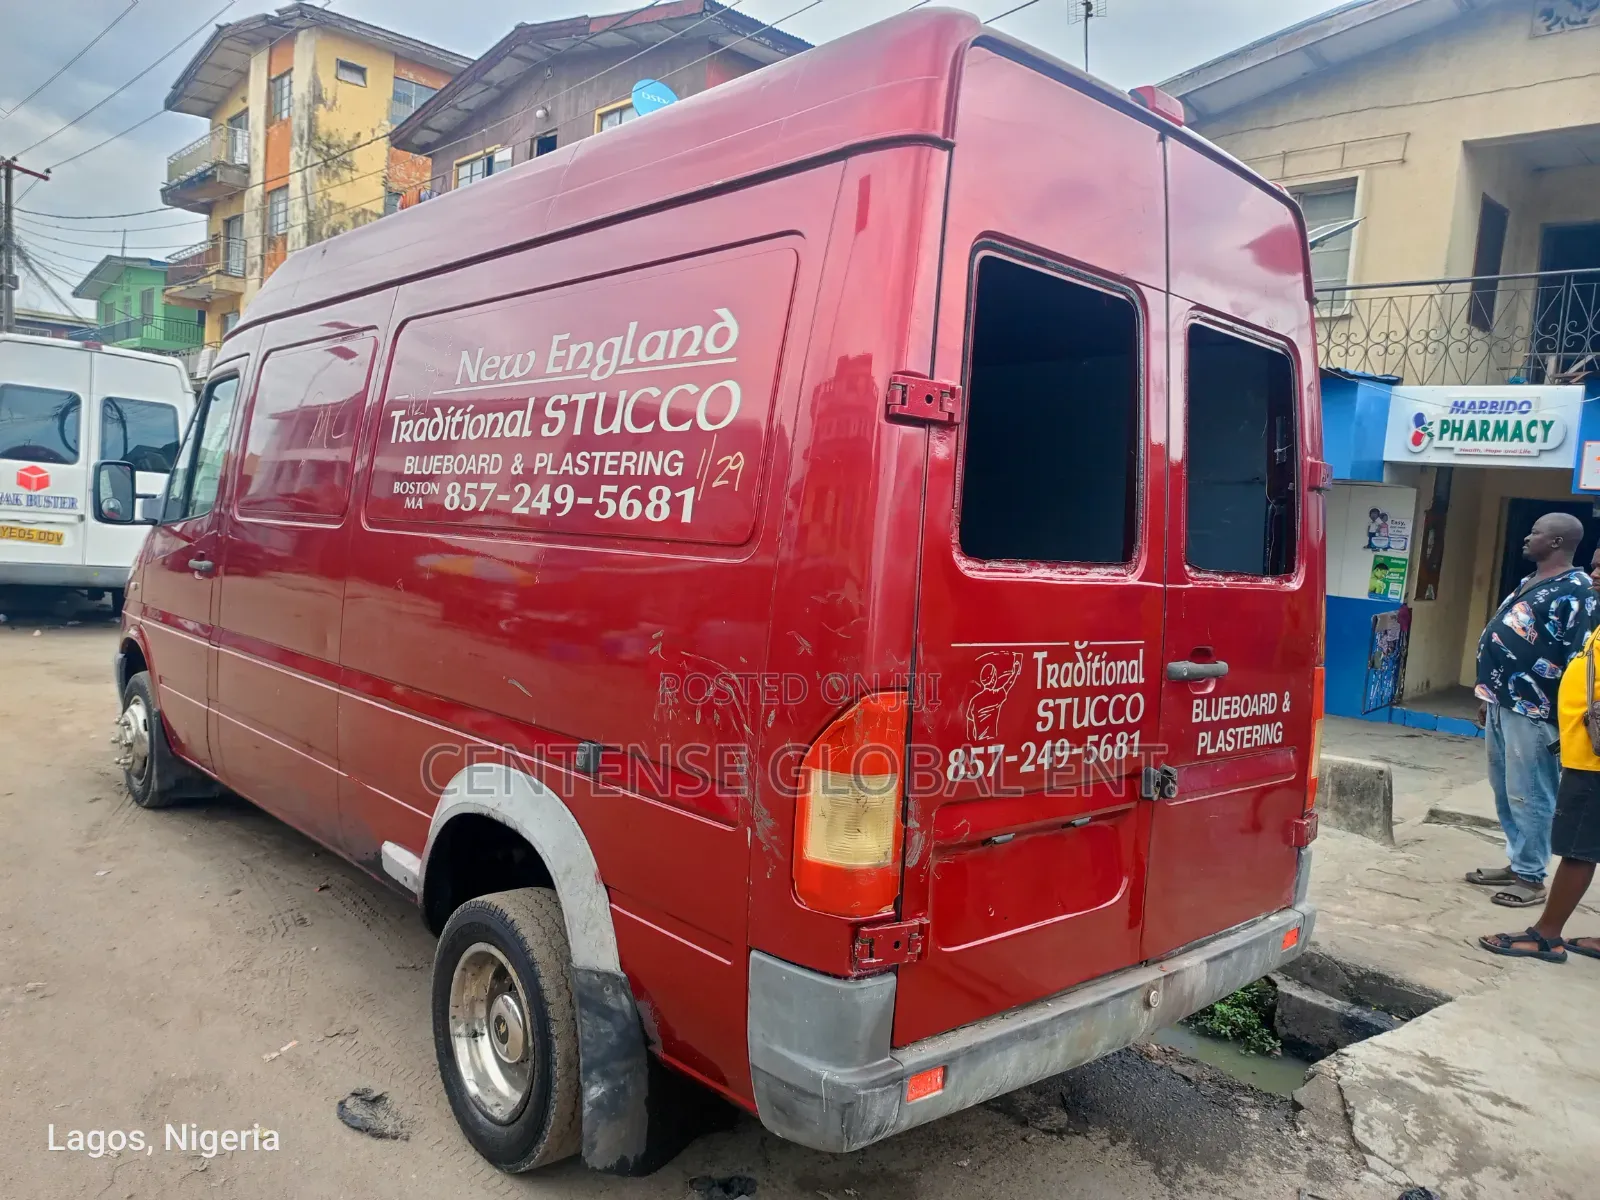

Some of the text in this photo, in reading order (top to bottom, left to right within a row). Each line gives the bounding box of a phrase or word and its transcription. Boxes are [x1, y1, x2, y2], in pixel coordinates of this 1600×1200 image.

[455, 308, 740, 385] New England
[390, 379, 742, 443] Traditional STUCCO
[1438, 419, 1556, 444] PHARMACY
[403, 450, 684, 476] BLUEBOARD & PLASTERING
[26, 494, 79, 510] BUSTER
[393, 481, 440, 495] BOSTON
[404, 496, 423, 510] MA
[443, 482, 696, 523] 857-249-5681
[1033, 648, 1145, 690] Traditional
[1036, 692, 1145, 733] STUCCO
[1191, 690, 1291, 723] BLUEBOARD &
[946, 730, 1141, 782] 857-249-5681
[1197, 721, 1283, 756] PLASTERING
